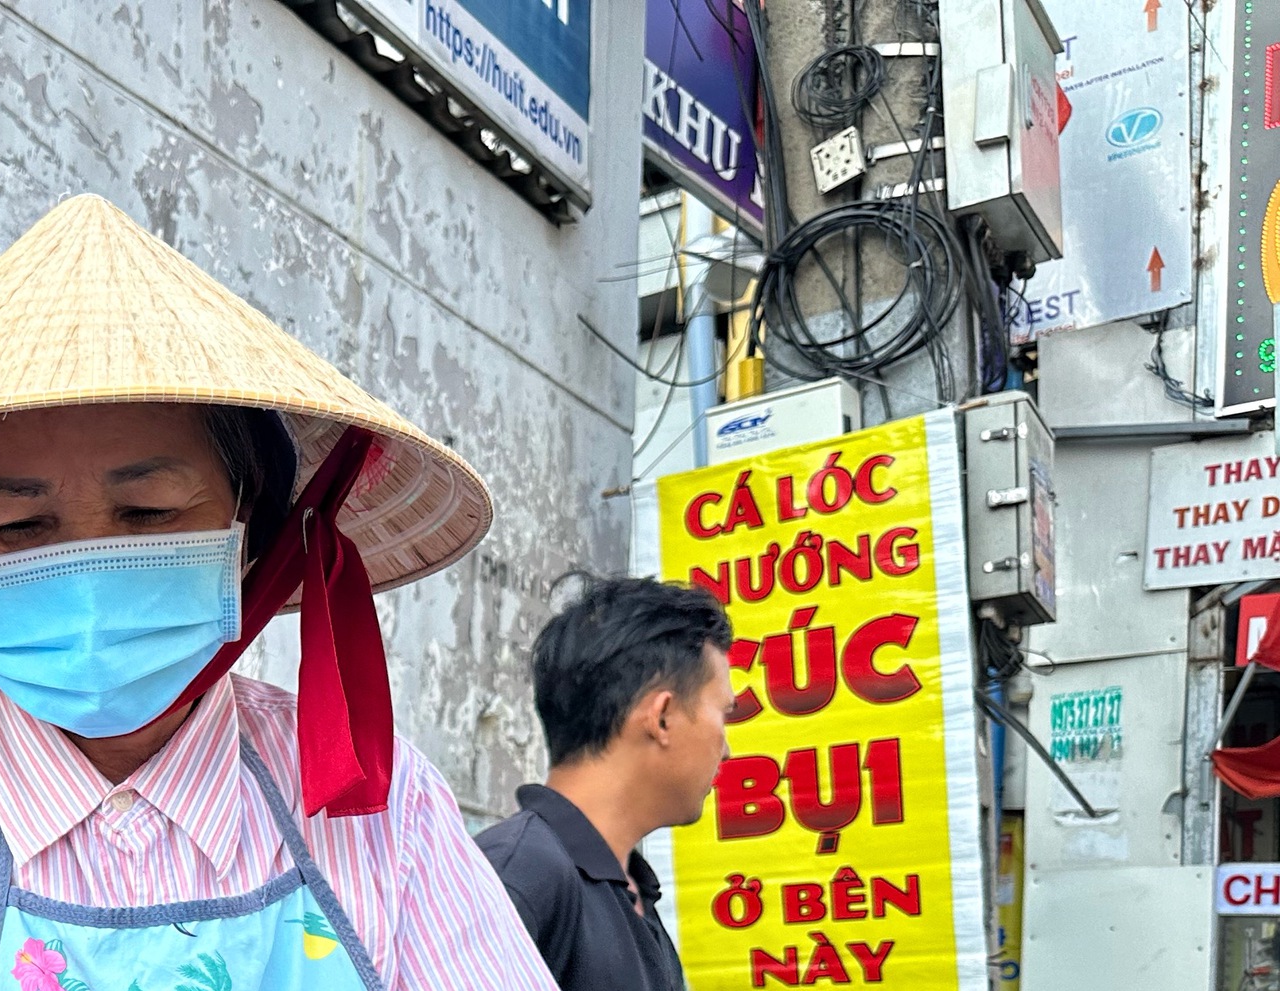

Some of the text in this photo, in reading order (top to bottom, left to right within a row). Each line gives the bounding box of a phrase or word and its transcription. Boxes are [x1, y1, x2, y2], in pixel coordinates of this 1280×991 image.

[426, 0, 582, 165] https://huit.edu.vn
[642, 57, 742, 181] KHU
[684, 451, 898, 539] CÁ LÓC
[1204, 456, 1280, 487] THAY
[1173, 498, 1250, 529] THAY
[689, 526, 921, 606] NƯỚNG
[1153, 540, 1230, 570] THAY
[711, 737, 904, 855] BỤI
[711, 866, 921, 928] Ở BÊN
[1223, 874, 1280, 906] CH
[750, 932, 895, 988] NÀY
